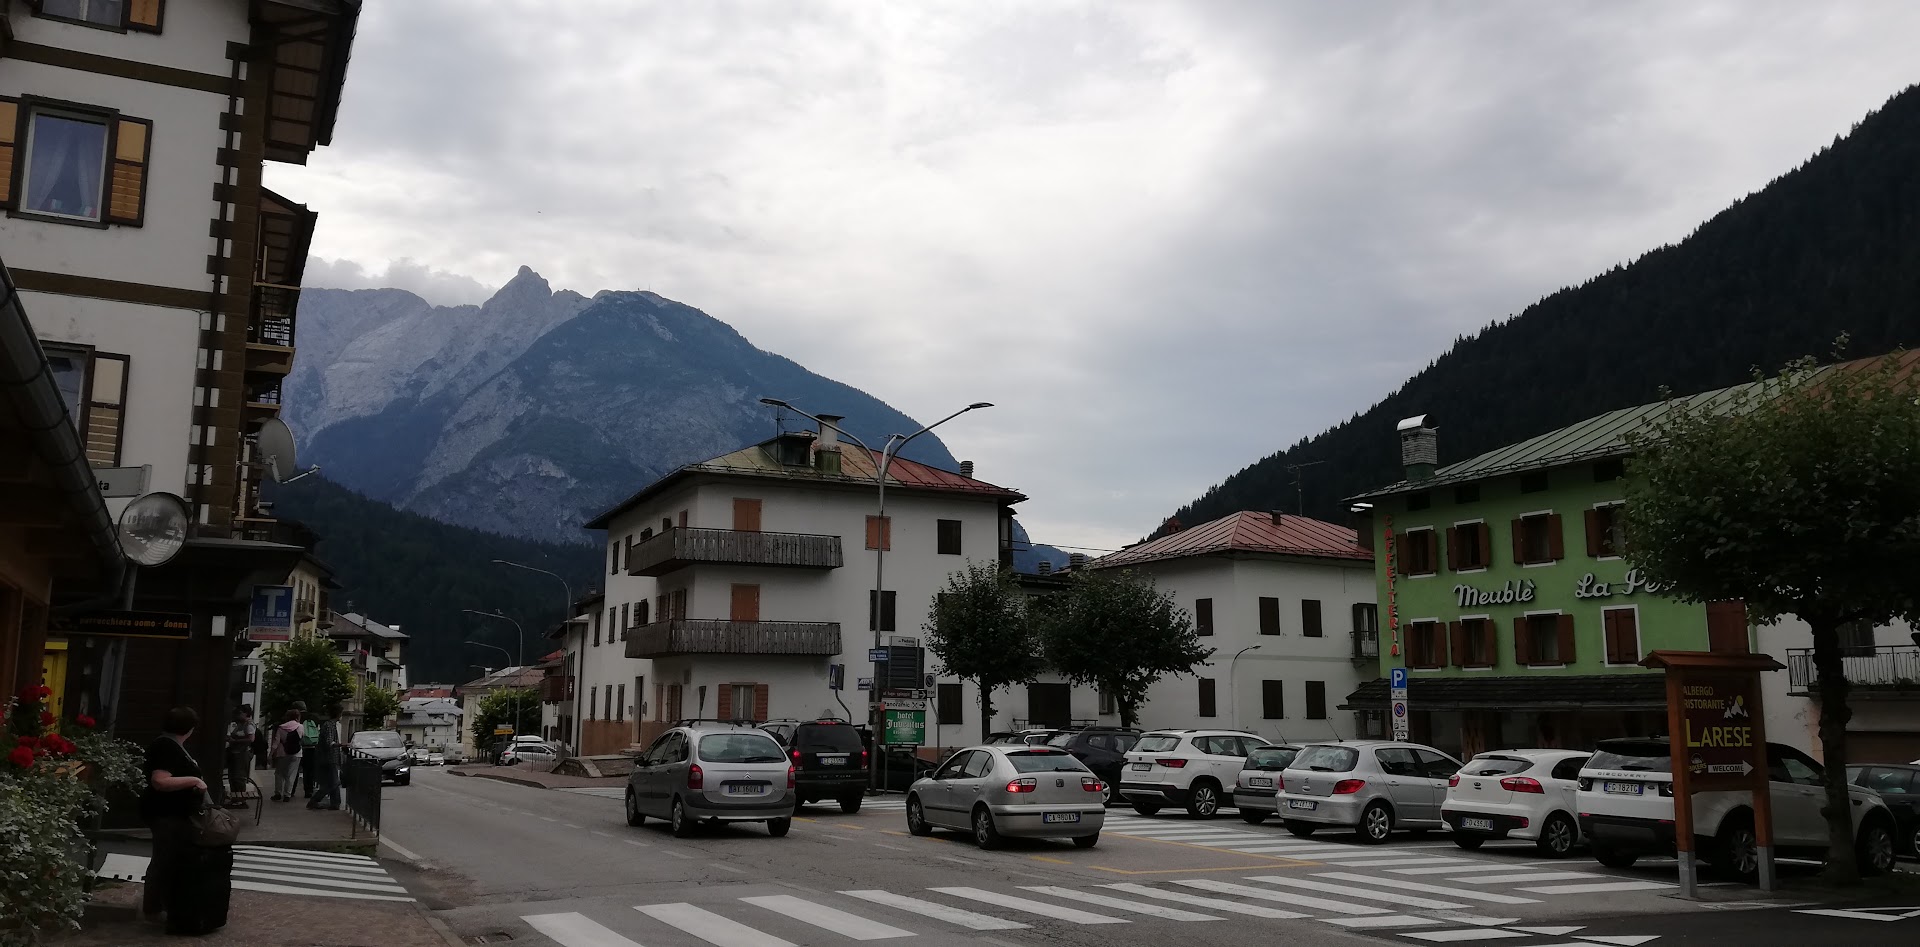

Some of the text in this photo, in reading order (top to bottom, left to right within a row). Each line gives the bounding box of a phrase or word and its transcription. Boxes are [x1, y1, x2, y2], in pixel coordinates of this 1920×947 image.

[1384, 514, 1400, 656] CAFFETTERIA
[1453, 578, 1536, 607] Meublè
[1575, 572, 1612, 598] La
[134, 618, 156, 628] uomo
[163, 619, 188, 629] donna
[1683, 686, 1714, 696] ALBERGO
[1684, 699, 1725, 710] RISTORANTE
[897, 711, 915, 720] hotel
[886, 718, 925, 730] Juventus
[1712, 764, 1745, 772] WELCOME
